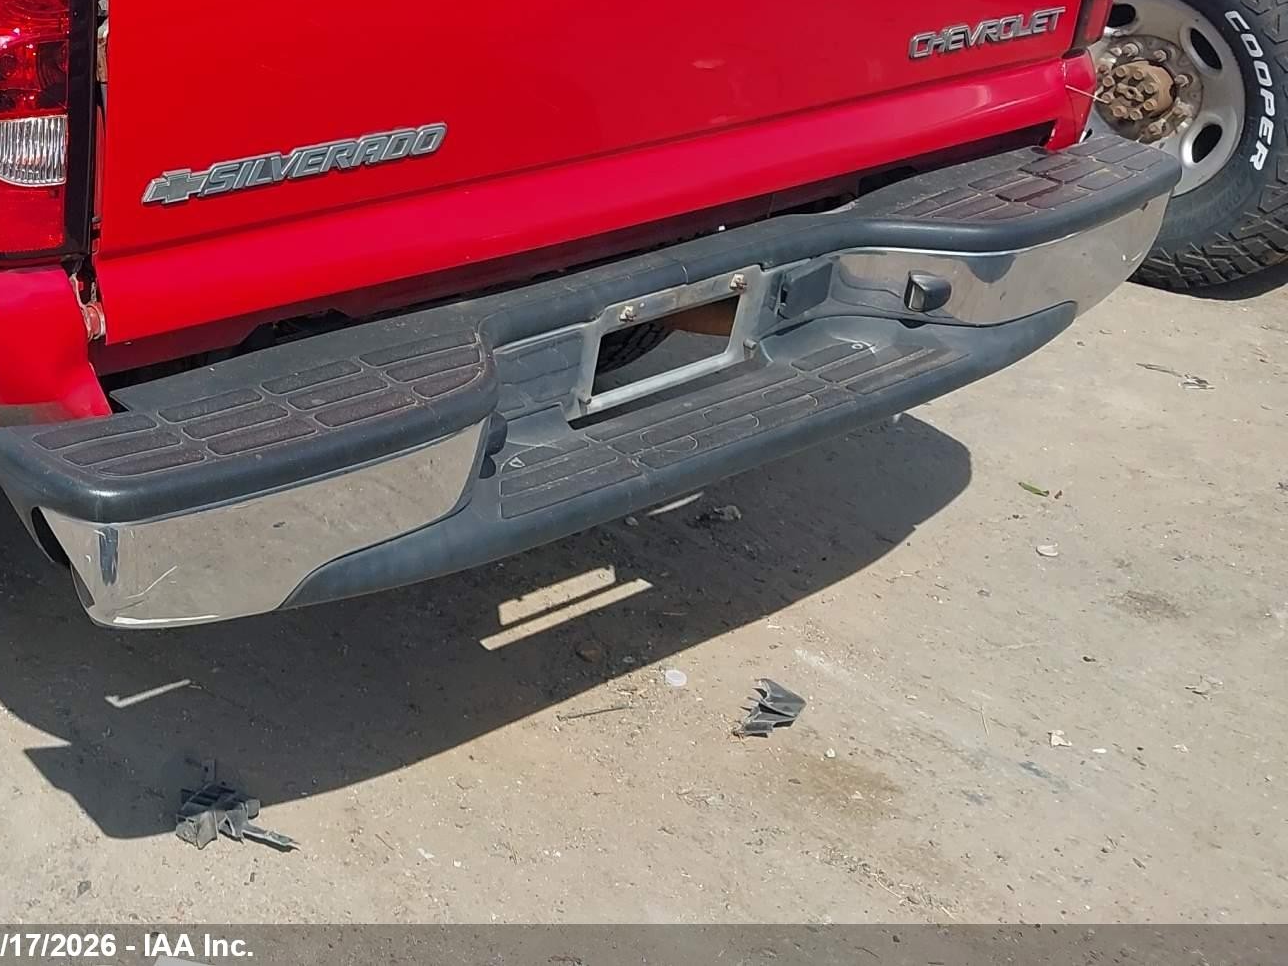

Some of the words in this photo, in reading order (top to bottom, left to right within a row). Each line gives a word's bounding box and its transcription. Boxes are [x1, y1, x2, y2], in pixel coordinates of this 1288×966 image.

[909, 6, 1066, 59] CHEVROLET
[1224, 10, 1275, 171] COOPER
[202, 122, 447, 198] SILVERADO
